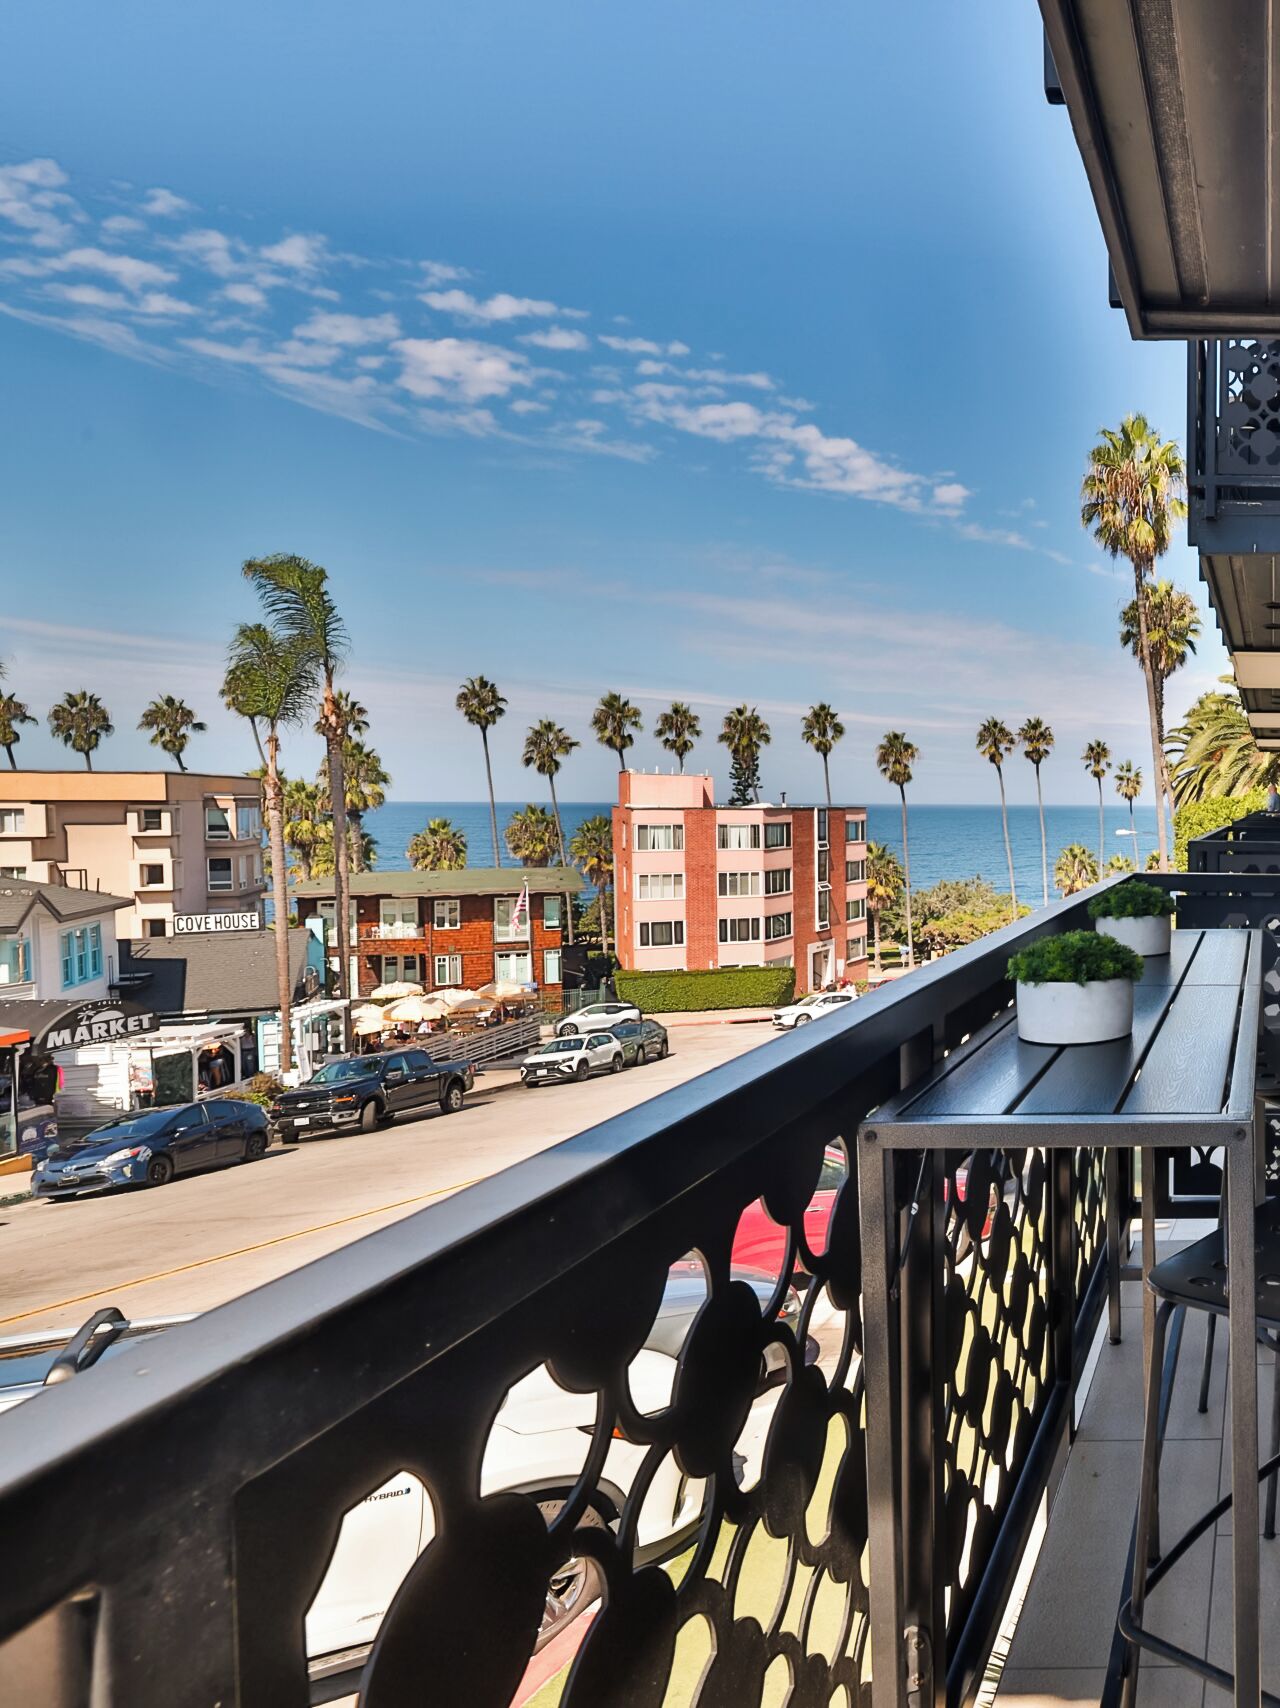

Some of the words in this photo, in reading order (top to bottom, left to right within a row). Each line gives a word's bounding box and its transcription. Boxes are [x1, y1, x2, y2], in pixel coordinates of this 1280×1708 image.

[177, 916, 211, 931] COVE
[214, 914, 257, 930] HOUSE
[46, 1012, 154, 1049] MARKET
[364, 1489, 404, 1503] HYBRID
